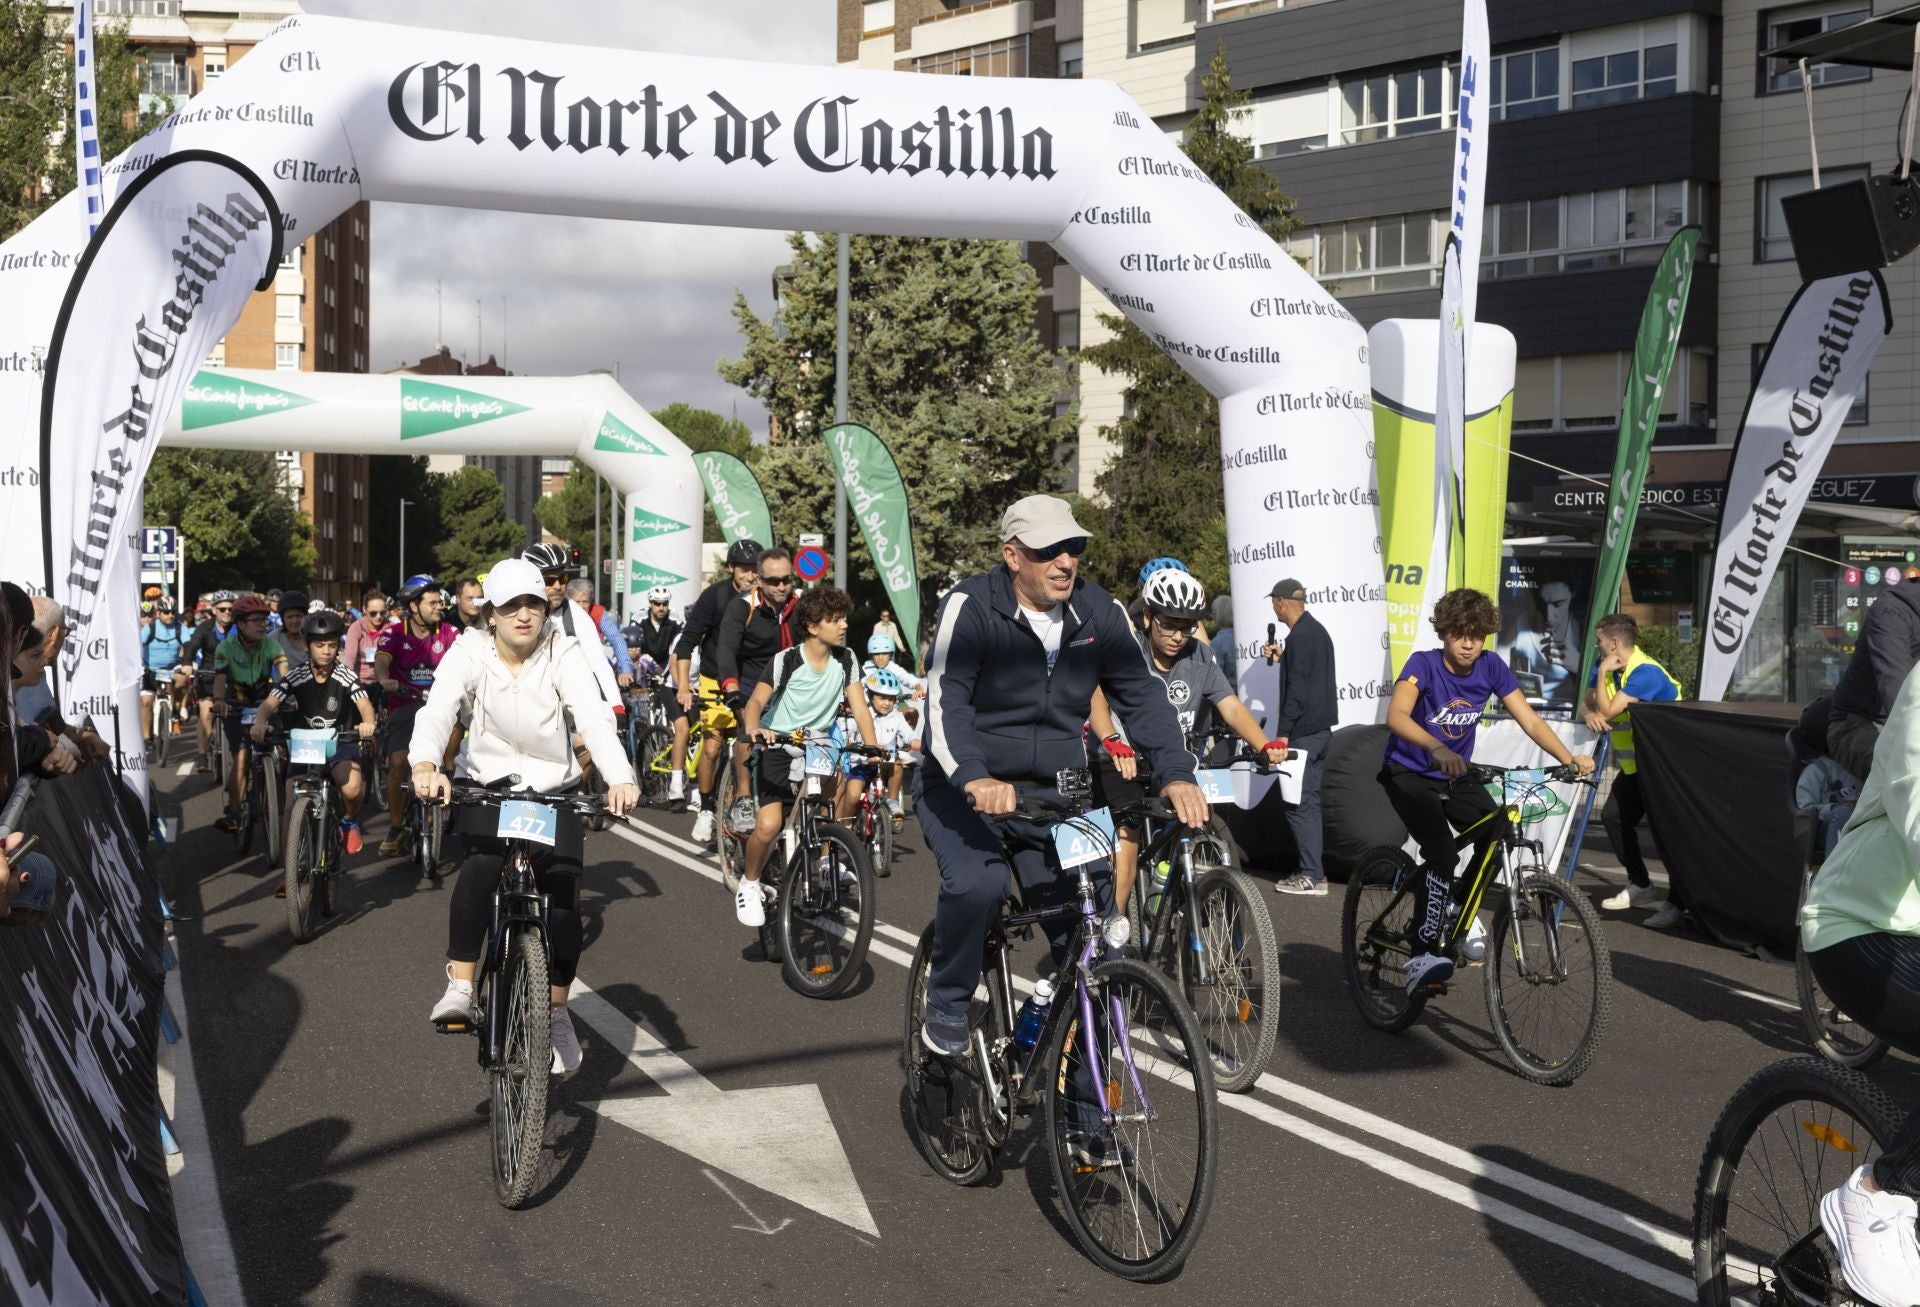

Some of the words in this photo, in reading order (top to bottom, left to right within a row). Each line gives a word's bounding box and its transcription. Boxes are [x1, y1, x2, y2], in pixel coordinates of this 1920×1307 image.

[279, 52, 303, 73] El
[167, 104, 209, 129] Norte
[215, 105, 234, 121] de
[237, 101, 314, 128] Castilla
[387, 60, 489, 145] El
[497, 67, 698, 163] Norte
[706, 90, 782, 168] de
[793, 95, 1060, 182] Castilla
[1113, 111, 1140, 130] tilla
[273, 158, 298, 181] El
[302, 160, 348, 184] Norte
[1118, 156, 1139, 176] El
[1141, 156, 1179, 177] Norte
[1180, 164, 1194, 180] de
[1085, 206, 1152, 225] Castilla
[51, 250, 71, 268] de
[1120, 253, 1142, 273] El
[1146, 254, 1190, 273] Norte
[1194, 255, 1210, 271] de
[1213, 251, 1272, 271] Castilla
[1250, 298, 1271, 318] El
[1273, 297, 1312, 317] Norte
[1314, 300, 1328, 316] de
[1196, 344, 1213, 361] de
[1214, 345, 1281, 364] Castilla
[1788, 276, 1874, 438] Castilla
[66, 447, 133, 597] Norte
[103, 384, 153, 442] de
[132, 191, 268, 380] Castilla
[1257, 397, 1277, 416] El
[1280, 392, 1323, 412] Norte
[1326, 390, 1341, 408] de
[419, 397, 453, 414] Corte
[1234, 444, 1288, 468] Castilla
[1764, 439, 1804, 485] de
[29, 467, 40, 487] d
[1263, 491, 1284, 511] El
[1287, 489, 1330, 509] Norte
[1332, 488, 1348, 506] de
[1554, 492, 1605, 507] CENTR
[1638, 488, 1686, 505] ÉDICO
[1693, 487, 1724, 503] EST
[1810, 480, 1877, 503] EGUEZ
[1242, 540, 1295, 563] Castilla
[1723, 486, 1788, 597] Norte
[1510, 566, 1534, 574] BLEU
[1848, 571, 1857, 583] 3
[1340, 585, 1356, 602] de
[1505, 581, 1538, 589] CHANEL
[1847, 597, 1859, 607] B2
[1711, 597, 1750, 655] El
[1846, 621, 1858, 632] F3
[87, 638, 109, 661] El
[1347, 682, 1363, 700] de
[298, 749, 320, 759] 320
[510, 815, 546, 834] 477
[1418, 871, 1450, 943] LAKERS
